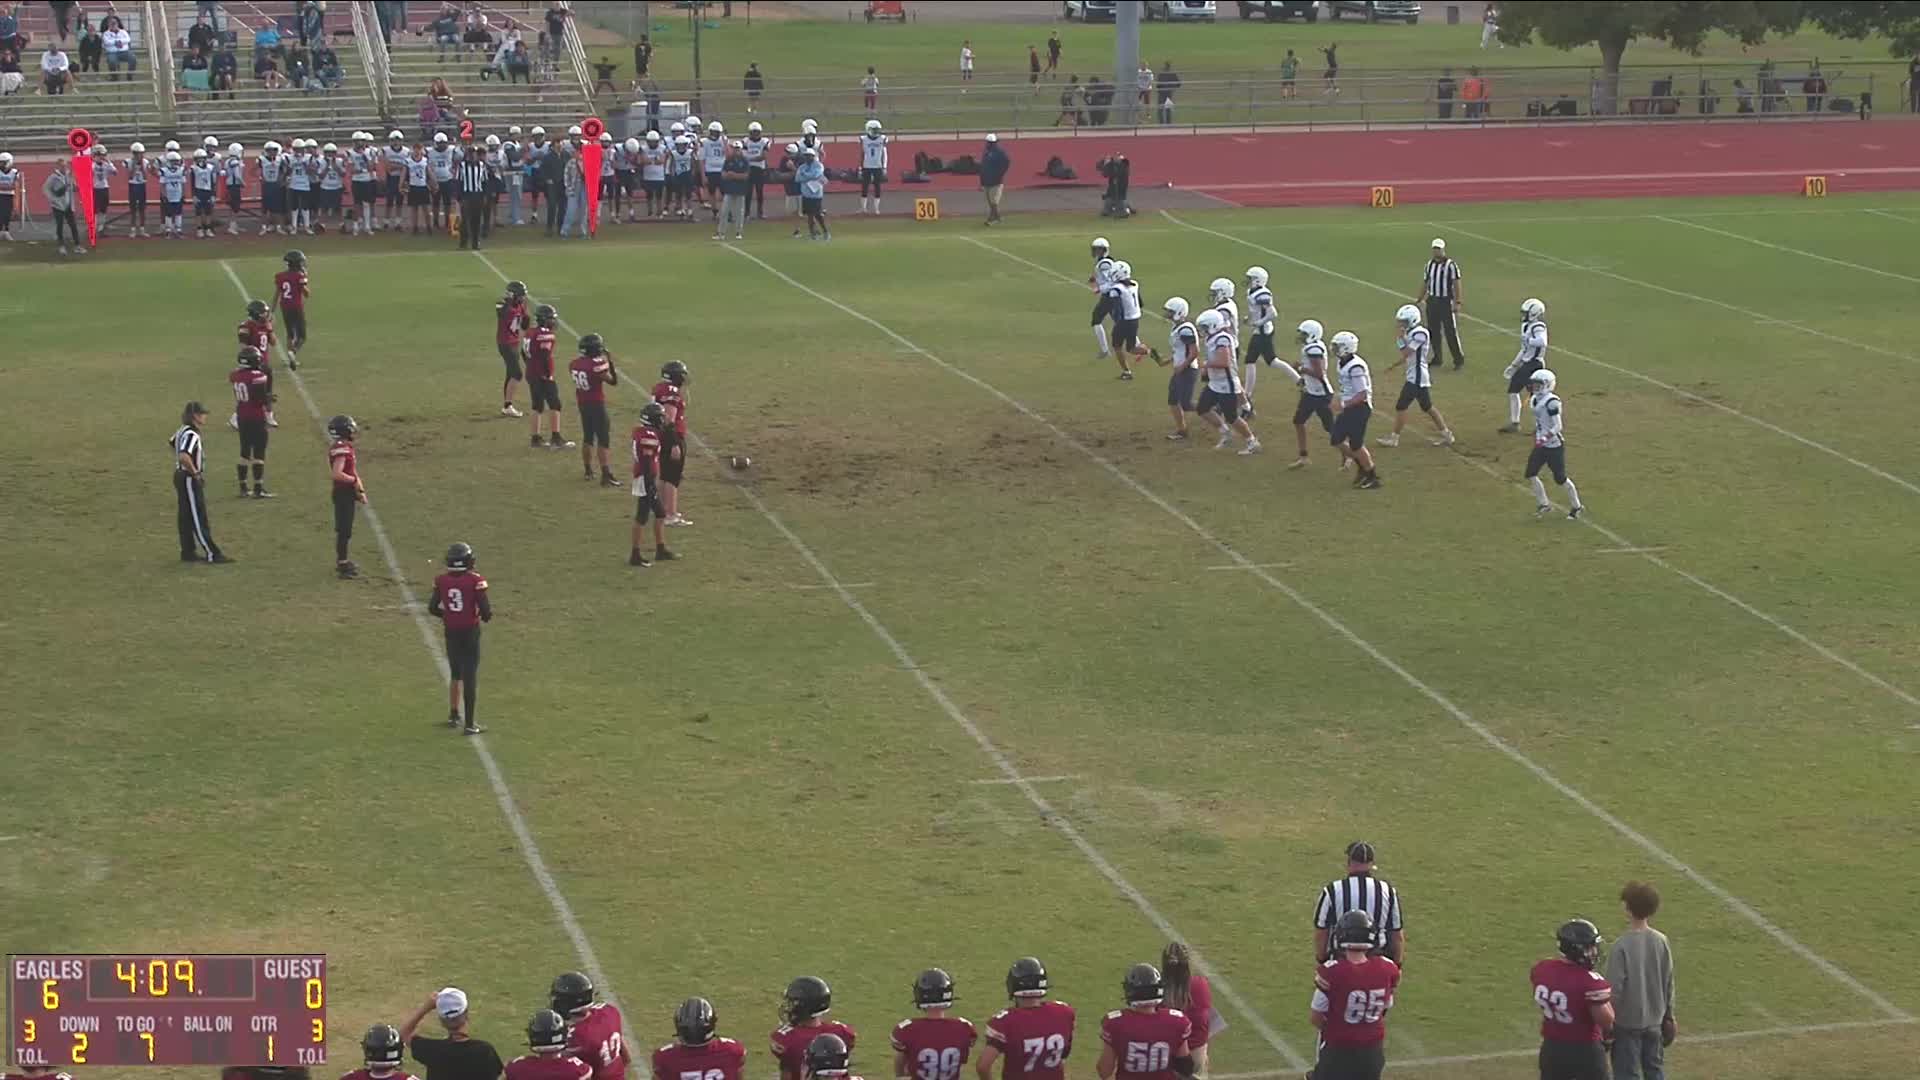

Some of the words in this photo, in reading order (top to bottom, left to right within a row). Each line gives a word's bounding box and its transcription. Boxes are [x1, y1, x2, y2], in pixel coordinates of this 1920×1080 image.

[460, 120, 473, 138] 2
[1808, 178, 1824, 196] 10
[1375, 188, 1391, 206] 20
[918, 202, 935, 218] 30
[282, 281, 292, 299] 2
[447, 588, 464, 612] 3
[1343, 988, 1385, 1024] 65
[1023, 1033, 1065, 1072] 73
[1125, 1041, 1170, 1072] 50
